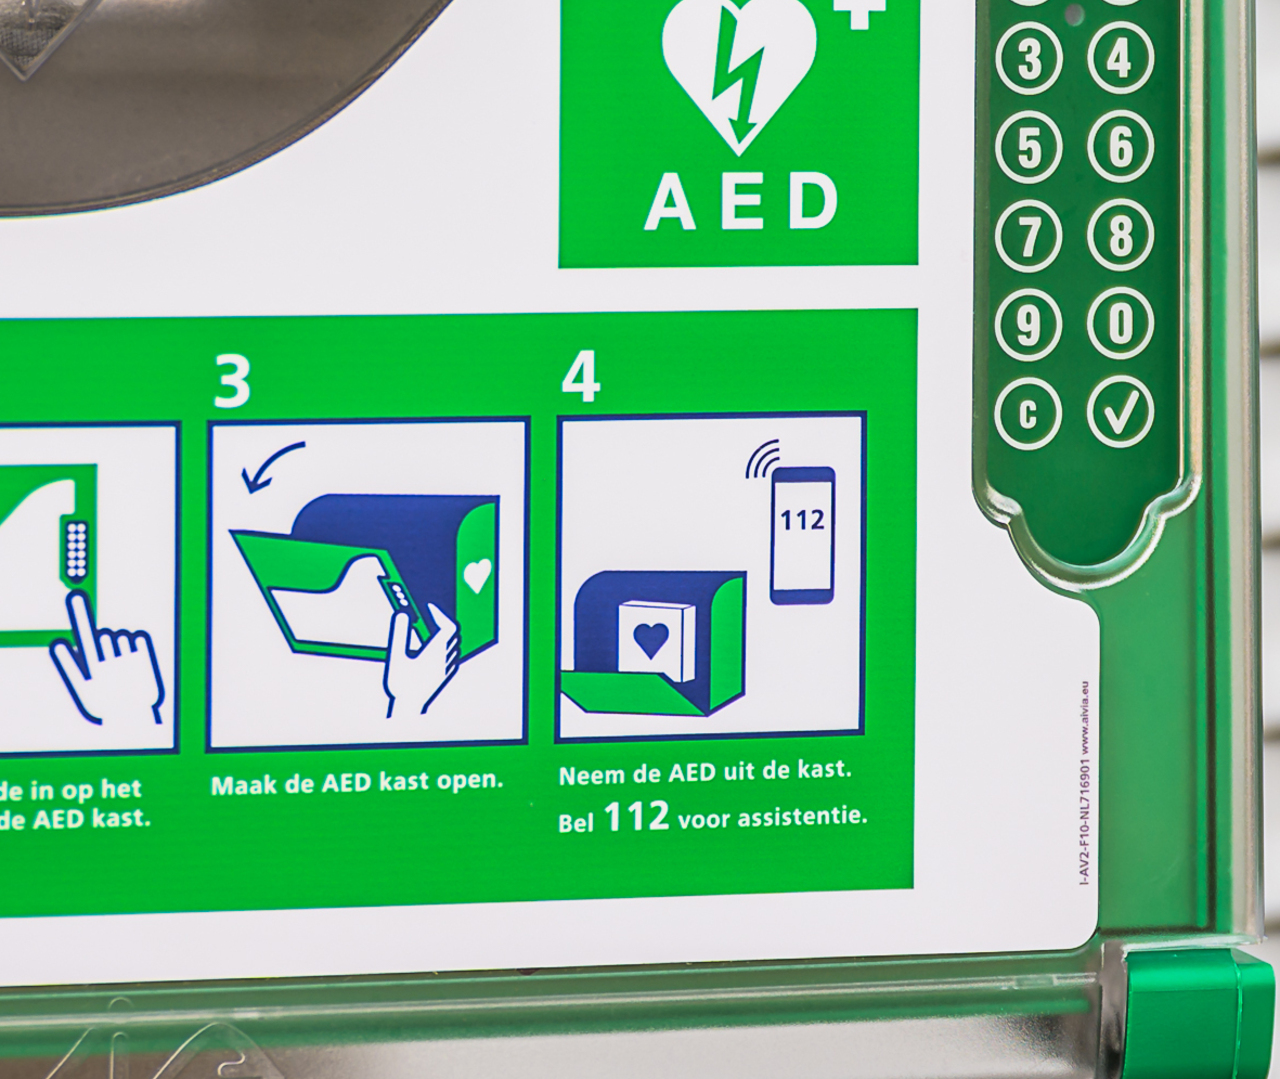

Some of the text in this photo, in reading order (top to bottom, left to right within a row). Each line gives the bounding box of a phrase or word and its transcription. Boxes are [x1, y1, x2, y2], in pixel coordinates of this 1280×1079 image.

[1018, 37, 1042, 80] 3
[1106, 36, 1132, 78] 4
[1018, 126, 1042, 169] 5
[1109, 125, 1134, 168] 6
[1018, 216, 1042, 258] 7
[1109, 214, 1134, 257] 8
[1016, 303, 1041, 347] 9
[1109, 301, 1134, 345] 0
[213, 353, 251, 409] 3
[561, 349, 602, 403] 4
[780, 508, 826, 531] 112
[1079, 680, 1090, 756] www.aivia.eu
[30, 779, 55, 801] in
[61, 782, 95, 808] op
[101, 778, 143, 800] het
[210, 769, 504, 797] Maak de AED kast open.
[558, 757, 853, 787] Neem de AED uit de kast.
[32, 808, 85, 831] AED
[91, 806, 152, 829] kast.
[558, 799, 869, 834] Bel 112 voor assistentie.
